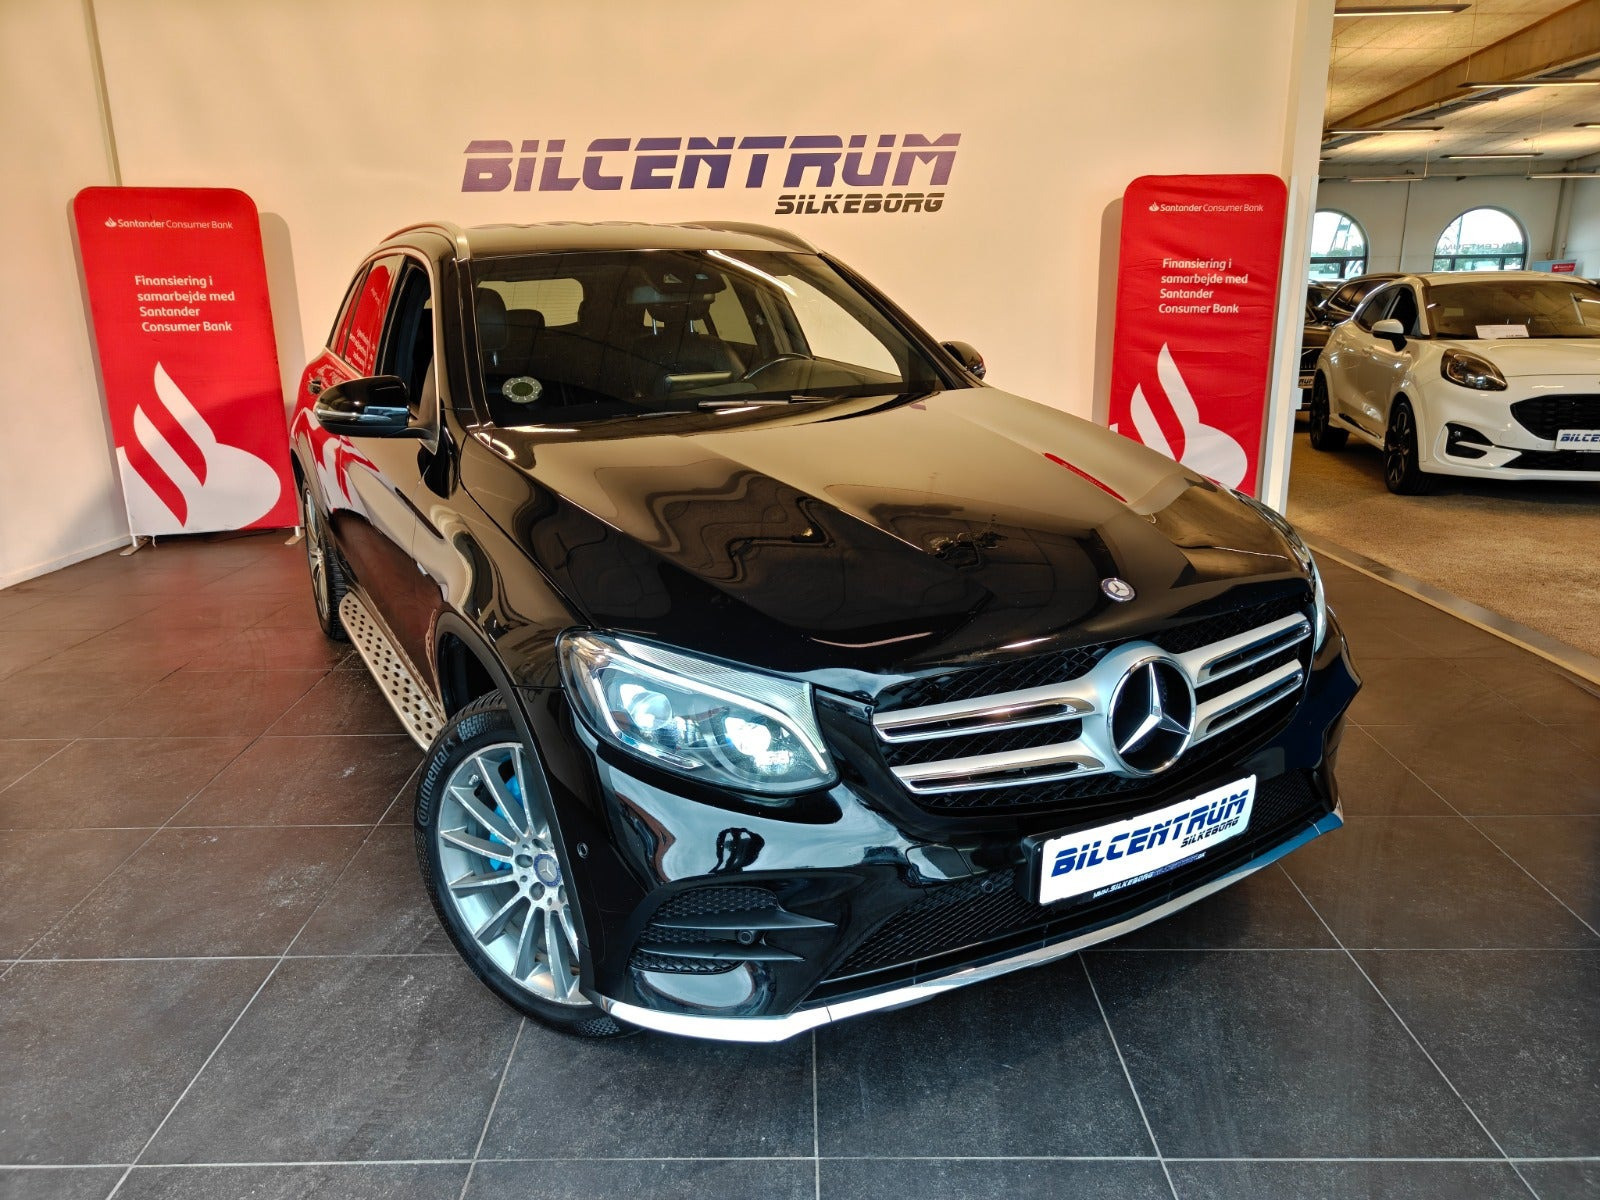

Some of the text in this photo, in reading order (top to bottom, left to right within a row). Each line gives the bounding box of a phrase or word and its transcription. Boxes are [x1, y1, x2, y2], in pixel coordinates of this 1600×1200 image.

[461, 133, 961, 192] BILCENTRUM
[775, 193, 945, 215] SILKEBORG
[1160, 203, 1264, 212] Santander Consumer Bank
[117, 219, 233, 229] Santander Consumer Bank
[1163, 258, 1232, 271] Finansiering i
[135, 275, 213, 288] Finansiering i
[1161, 273, 1249, 286] samarbejde med
[137, 291, 235, 304] samarbejde med
[1160, 288, 1214, 299] Santander
[139, 306, 200, 317] Santander
[1158, 304, 1239, 314] Consumer Bank
[142, 321, 232, 332] Consumer Bank
[1560, 433, 1600, 442] BILCE
[417, 743, 449, 826] Continental
[1051, 789, 1249, 877] BILCENTRUM
[1181, 816, 1240, 848] SILKEBORG
